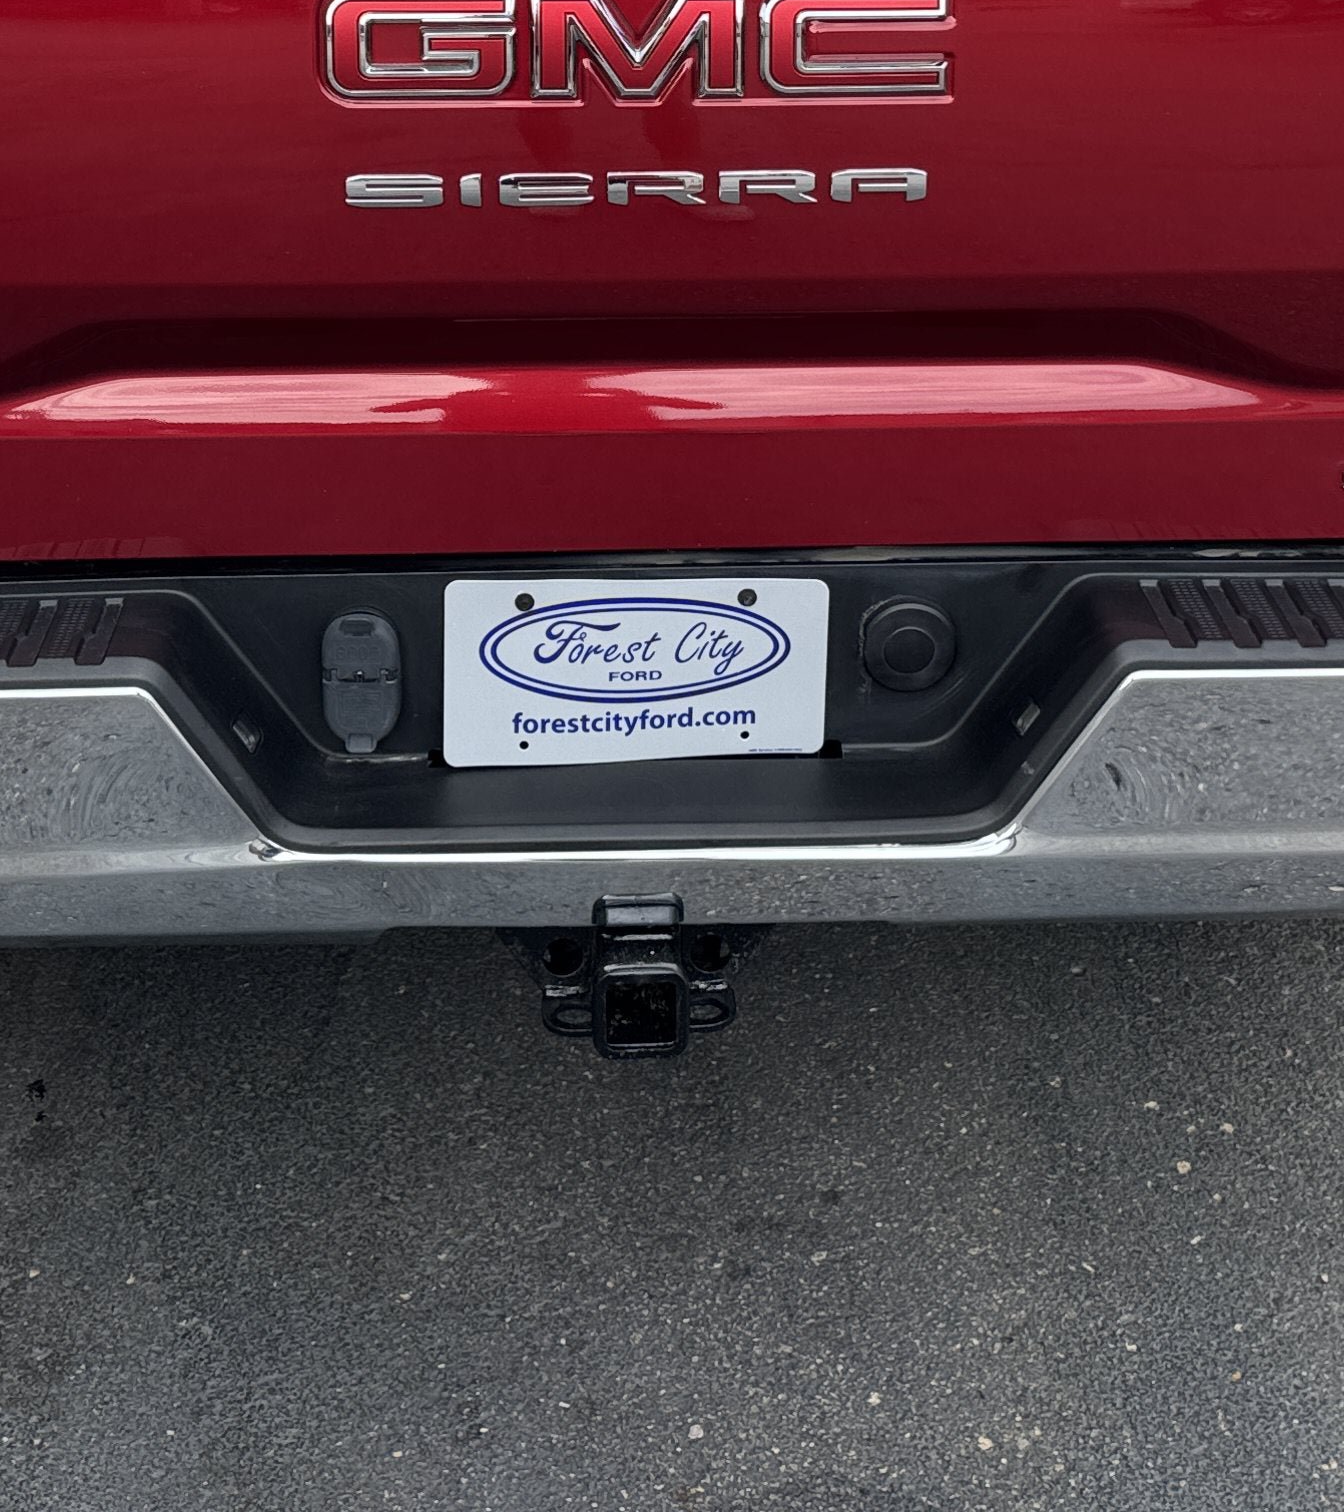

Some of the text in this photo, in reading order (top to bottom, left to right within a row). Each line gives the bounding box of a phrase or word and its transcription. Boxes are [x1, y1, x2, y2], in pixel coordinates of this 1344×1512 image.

[345, 168, 928, 208] SIERRA
[533, 620, 744, 676] Forest City
[607, 669, 663, 683] FORD
[512, 706, 756, 737] forestcityford.com
